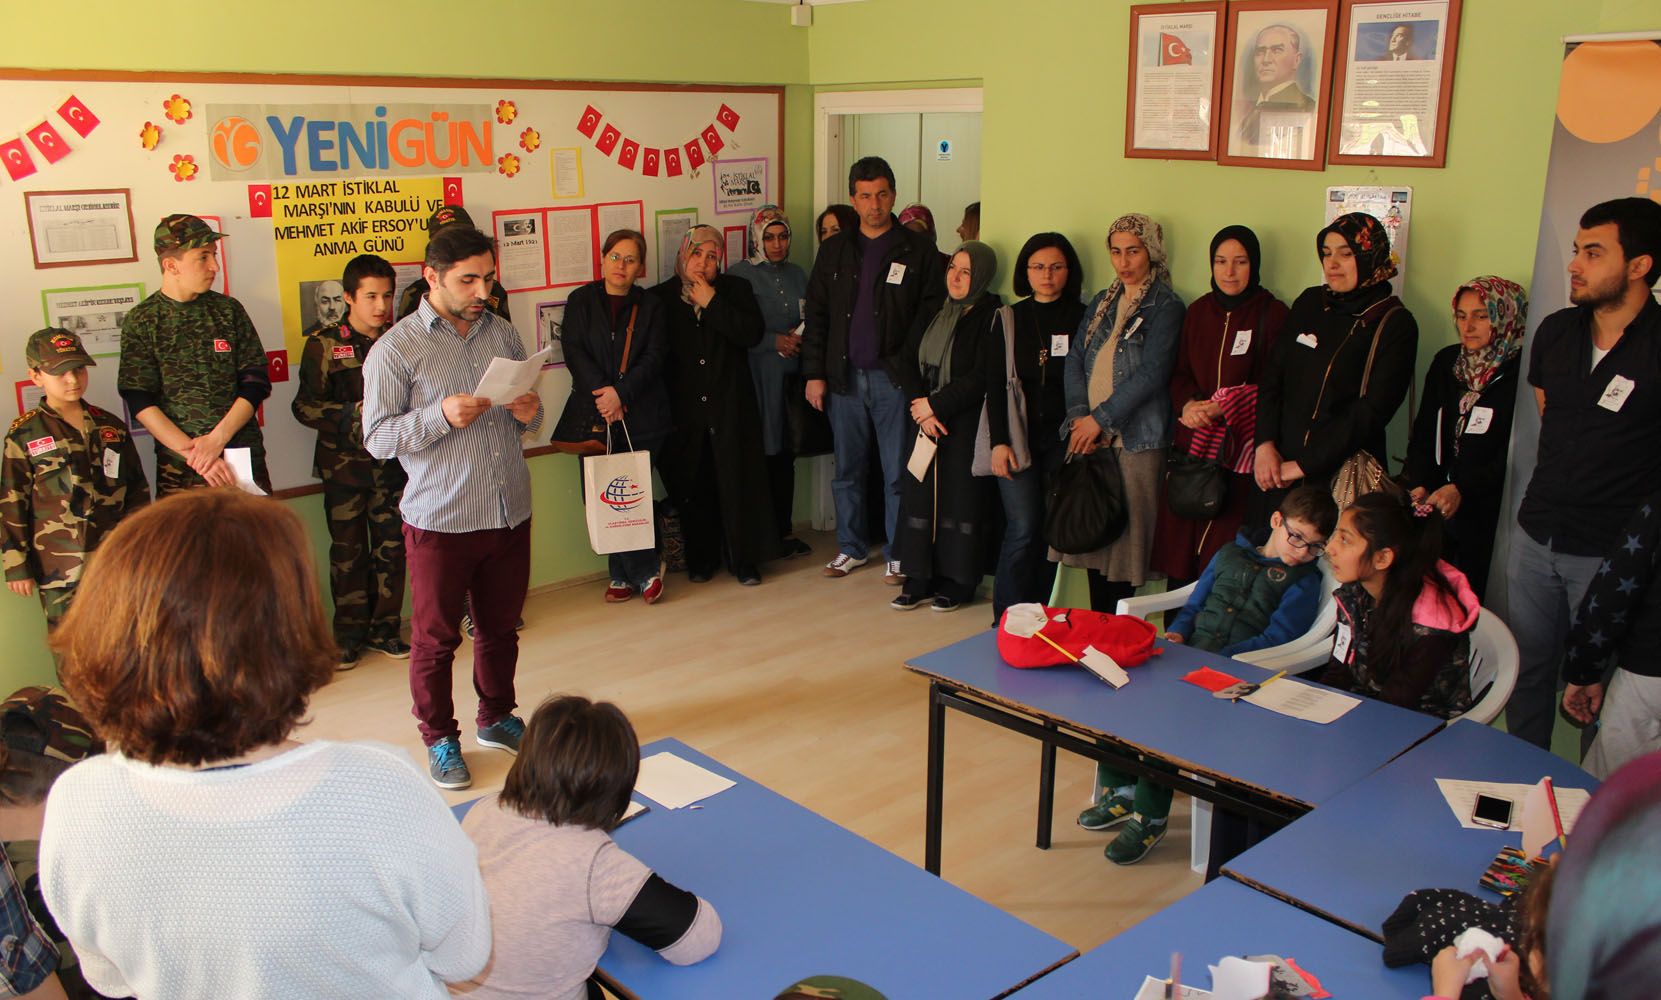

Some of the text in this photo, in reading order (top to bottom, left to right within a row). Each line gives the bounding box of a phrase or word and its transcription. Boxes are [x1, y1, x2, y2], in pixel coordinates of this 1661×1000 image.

[266, 106, 493, 175] YENİGÜN
[273, 180, 400, 199] 12 MART İSTİKLAL
[284, 202, 356, 219] MARŞI'NIN
[365, 196, 420, 213] KABULÜ
[426, 199, 443, 212] VE
[274, 223, 335, 240] MEHMET
[340, 218, 368, 236] AKİF
[314, 236, 405, 257] ANMA GÜNÜ
